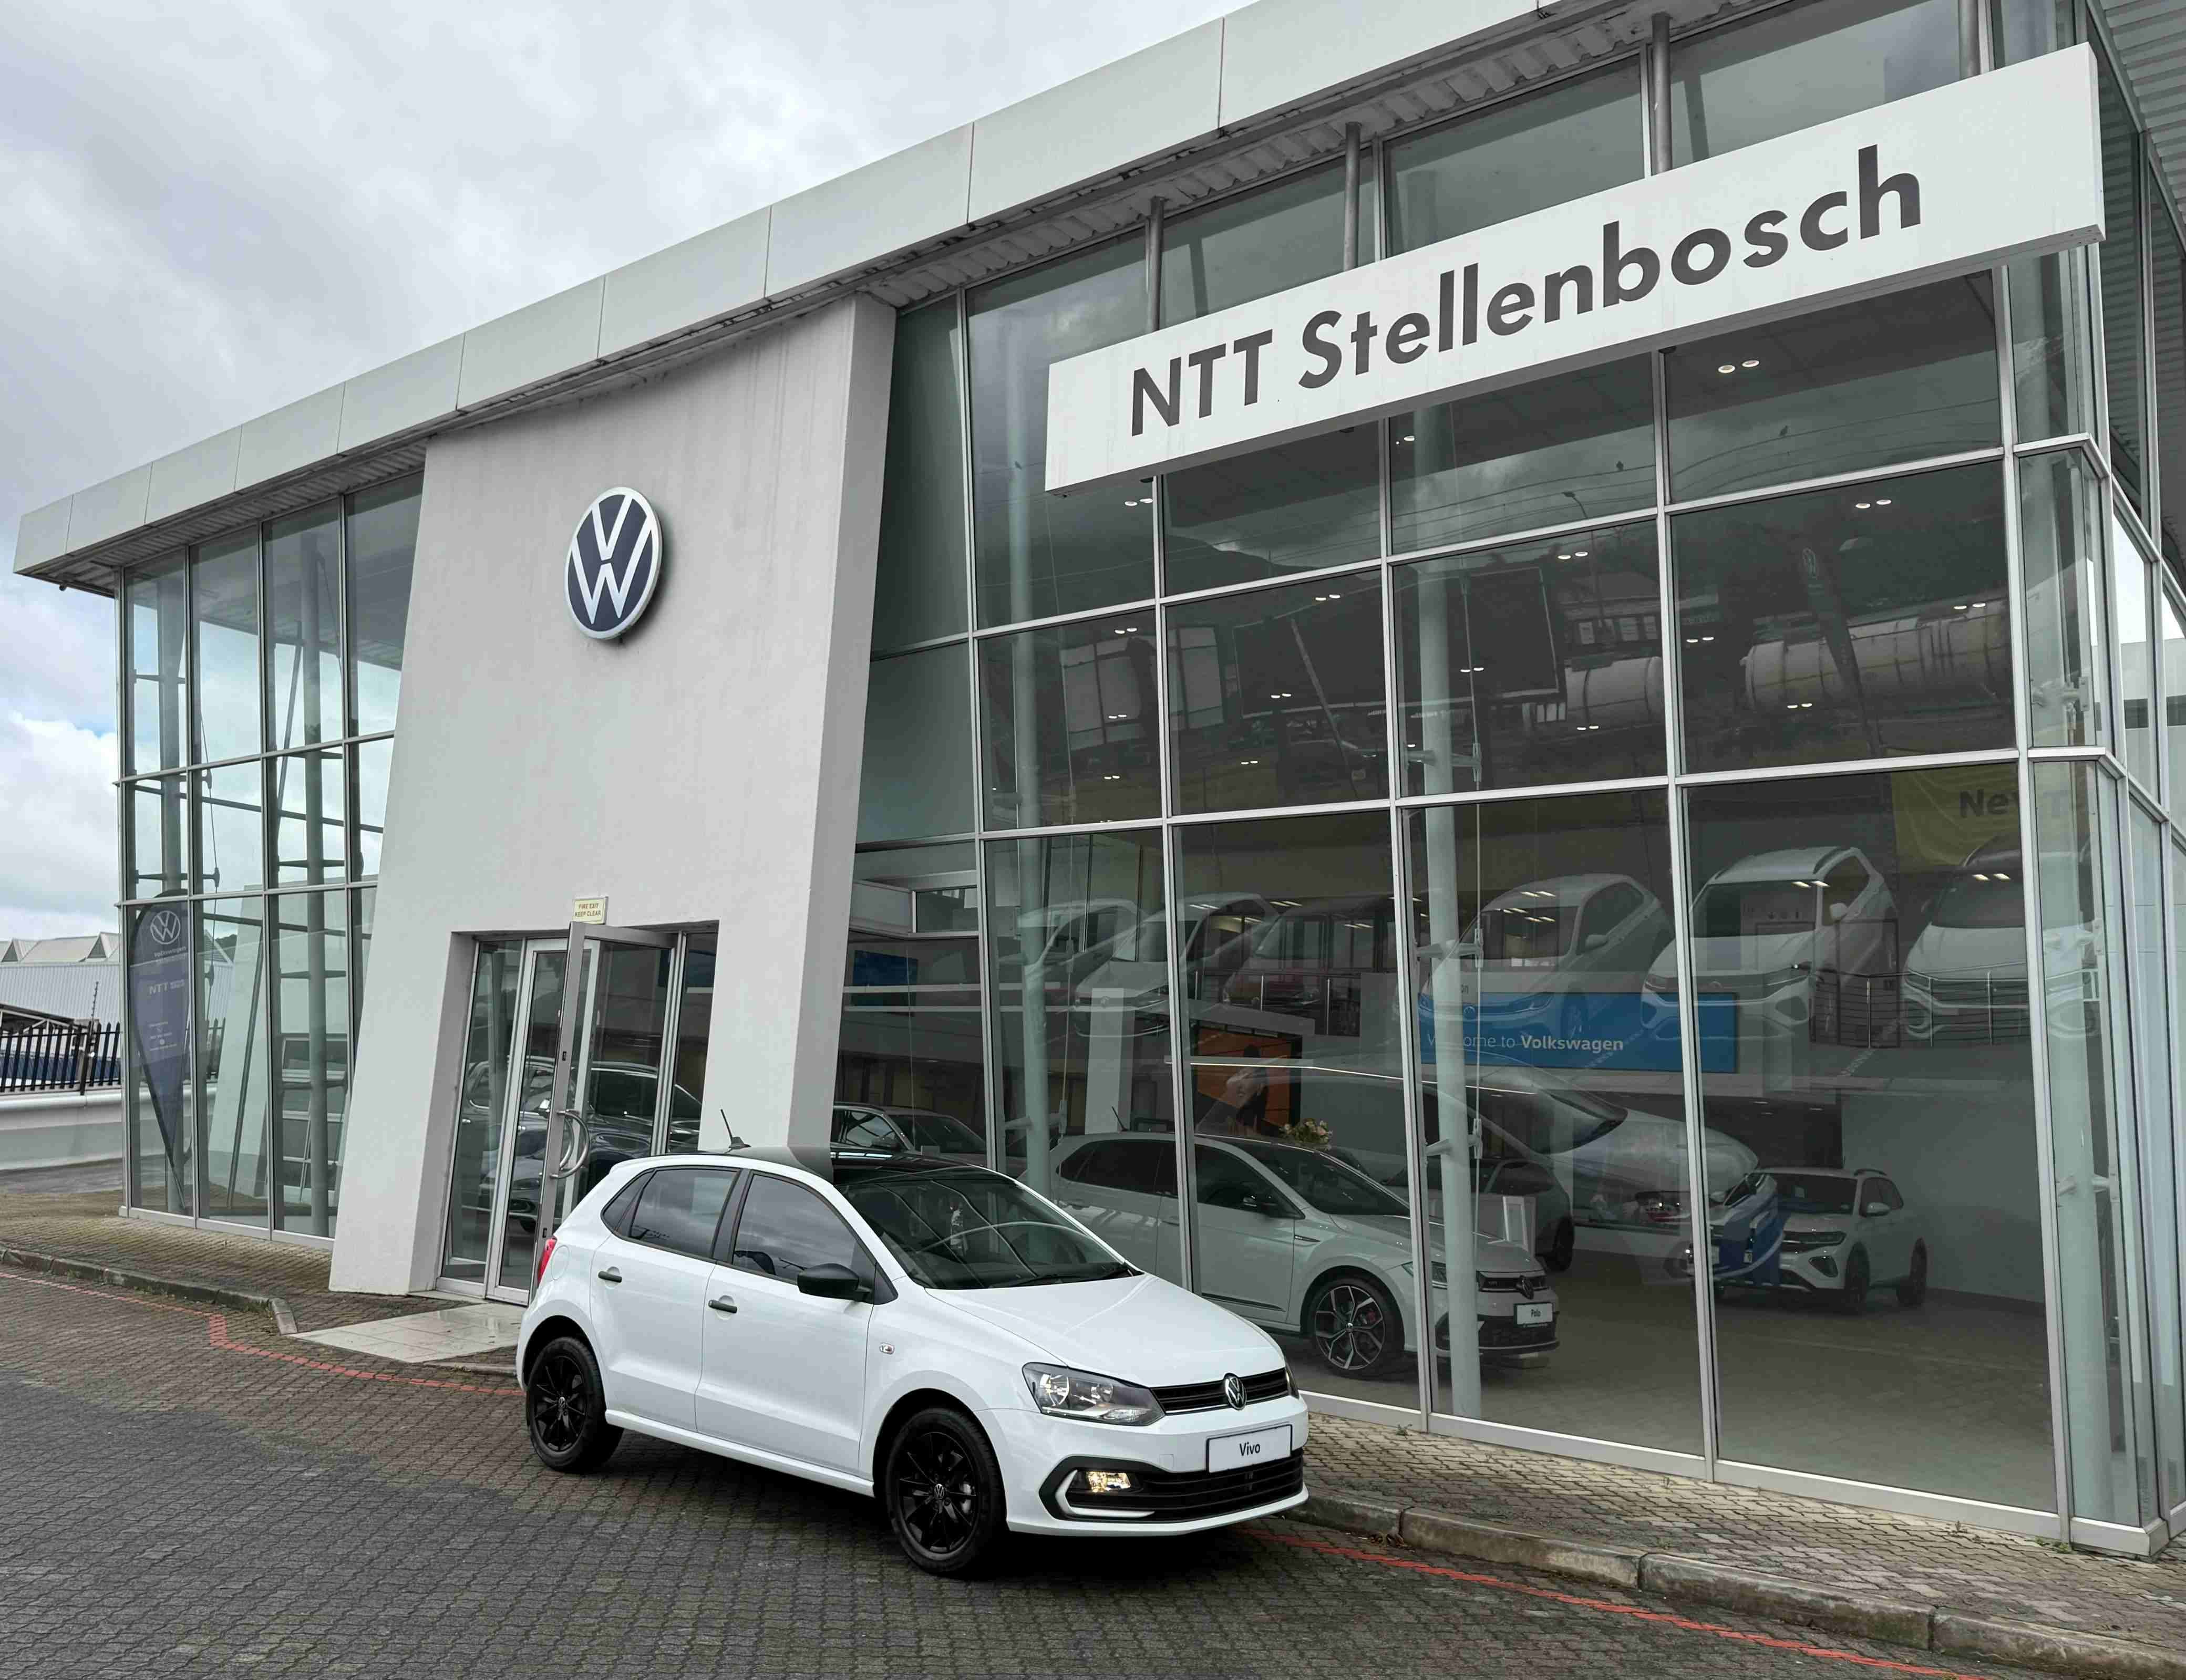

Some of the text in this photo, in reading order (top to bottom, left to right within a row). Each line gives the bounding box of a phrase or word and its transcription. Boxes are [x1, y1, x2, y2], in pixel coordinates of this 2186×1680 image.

[1132, 144, 1921, 437] NTT Stellenbosch
[568, 491, 657, 633] VW
[1960, 789, 2019, 818] Ne
[149, 981, 168, 994] NTT
[1501, 1036, 1515, 1049] to
[1521, 1034, 1623, 1053] Volkswagen
[1239, 1442, 1261, 1456] Vivo
